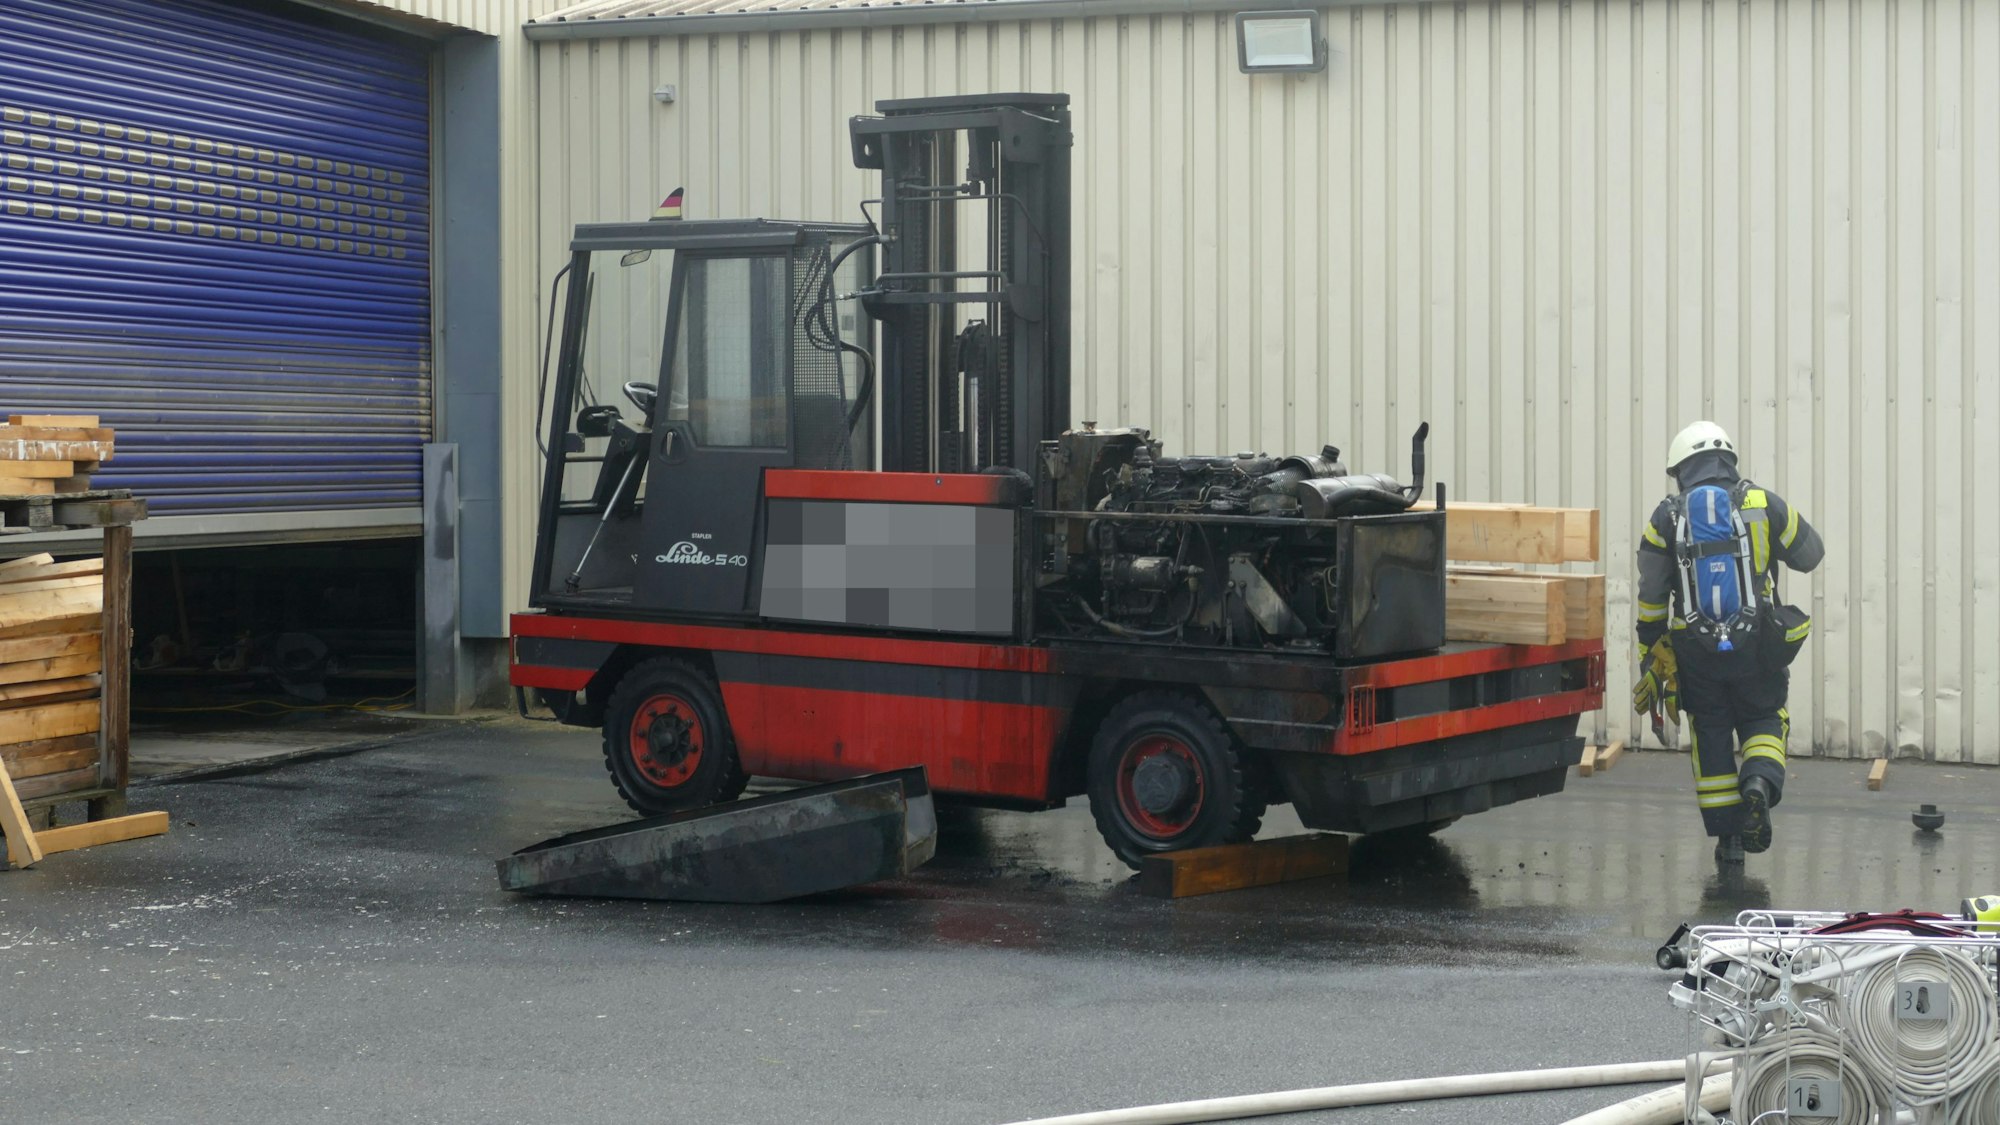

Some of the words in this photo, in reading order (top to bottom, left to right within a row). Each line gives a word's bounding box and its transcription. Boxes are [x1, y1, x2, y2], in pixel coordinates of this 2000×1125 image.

[655, 541, 715, 565] Linde
[1903, 990, 1913, 1010] 3
[1794, 1087, 1802, 1107] 1
